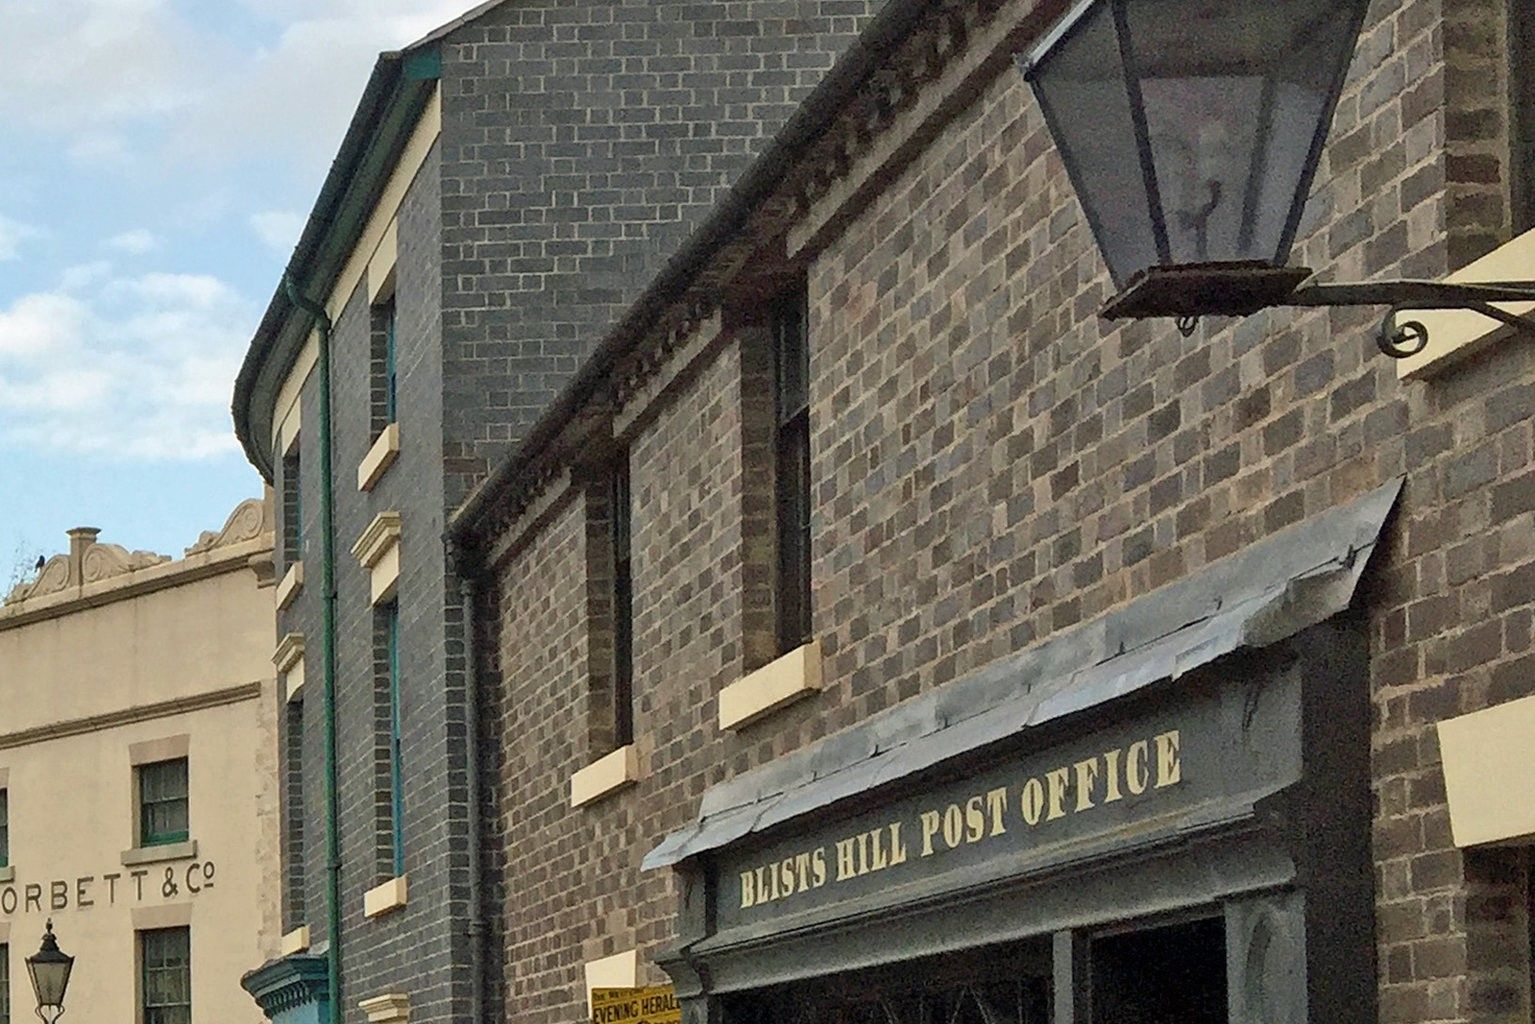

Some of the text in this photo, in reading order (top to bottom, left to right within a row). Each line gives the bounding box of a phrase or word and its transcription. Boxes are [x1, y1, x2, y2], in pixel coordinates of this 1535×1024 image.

[739, 730, 1182, 909] BLISTS HILL POST OFFICE
[161, 866, 179, 898] &
[592, 1000, 639, 1024] EVENING
